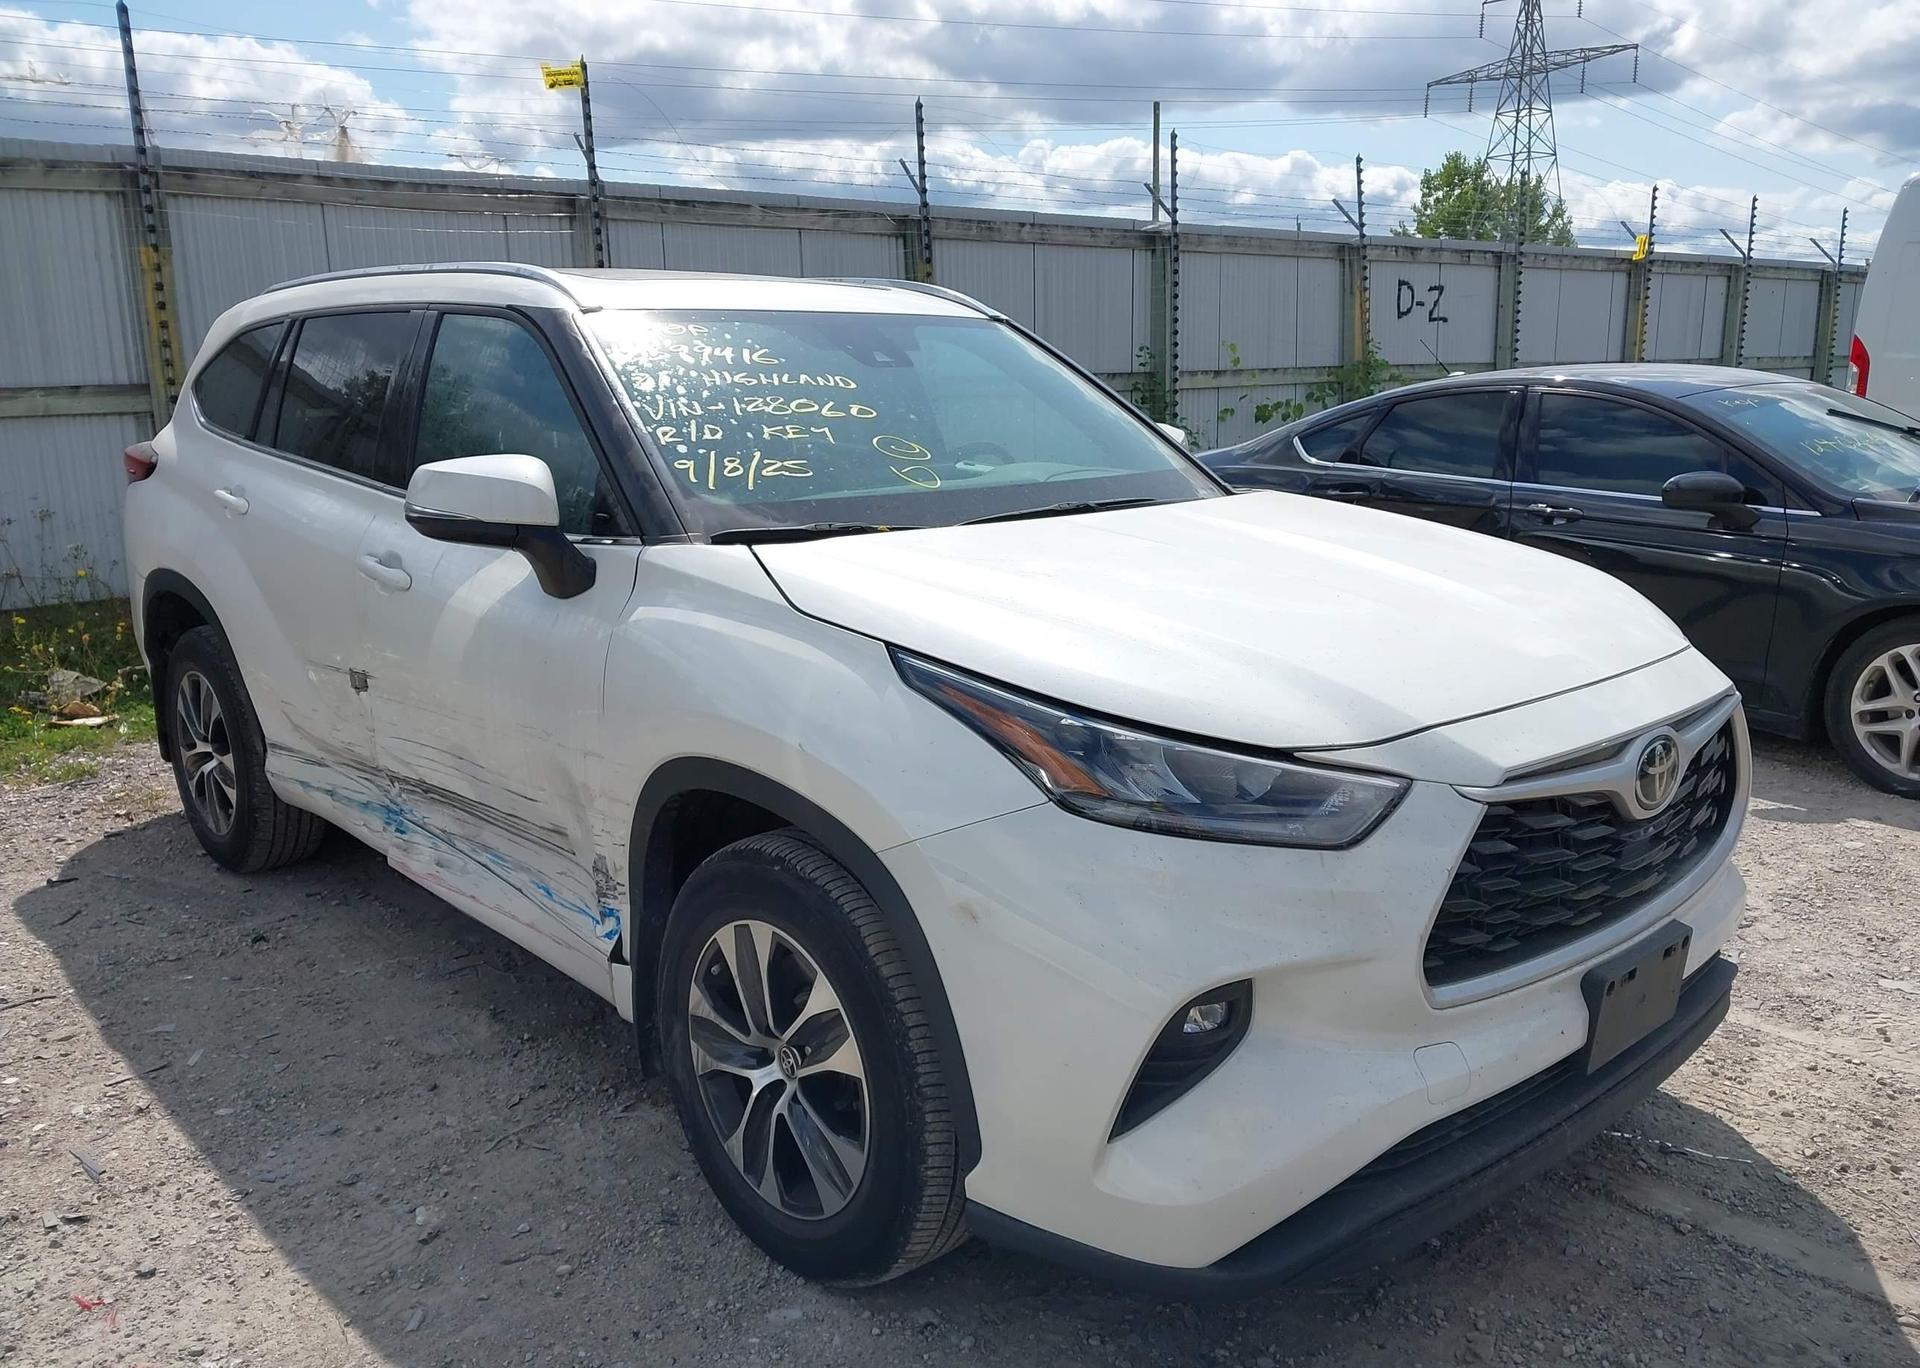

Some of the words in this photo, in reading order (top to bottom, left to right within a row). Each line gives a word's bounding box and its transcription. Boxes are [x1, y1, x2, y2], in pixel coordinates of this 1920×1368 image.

[703, 370, 857, 389] HIGHLAND
[761, 425, 835, 444] KEY
[673, 450, 813, 490] 9/8/25
